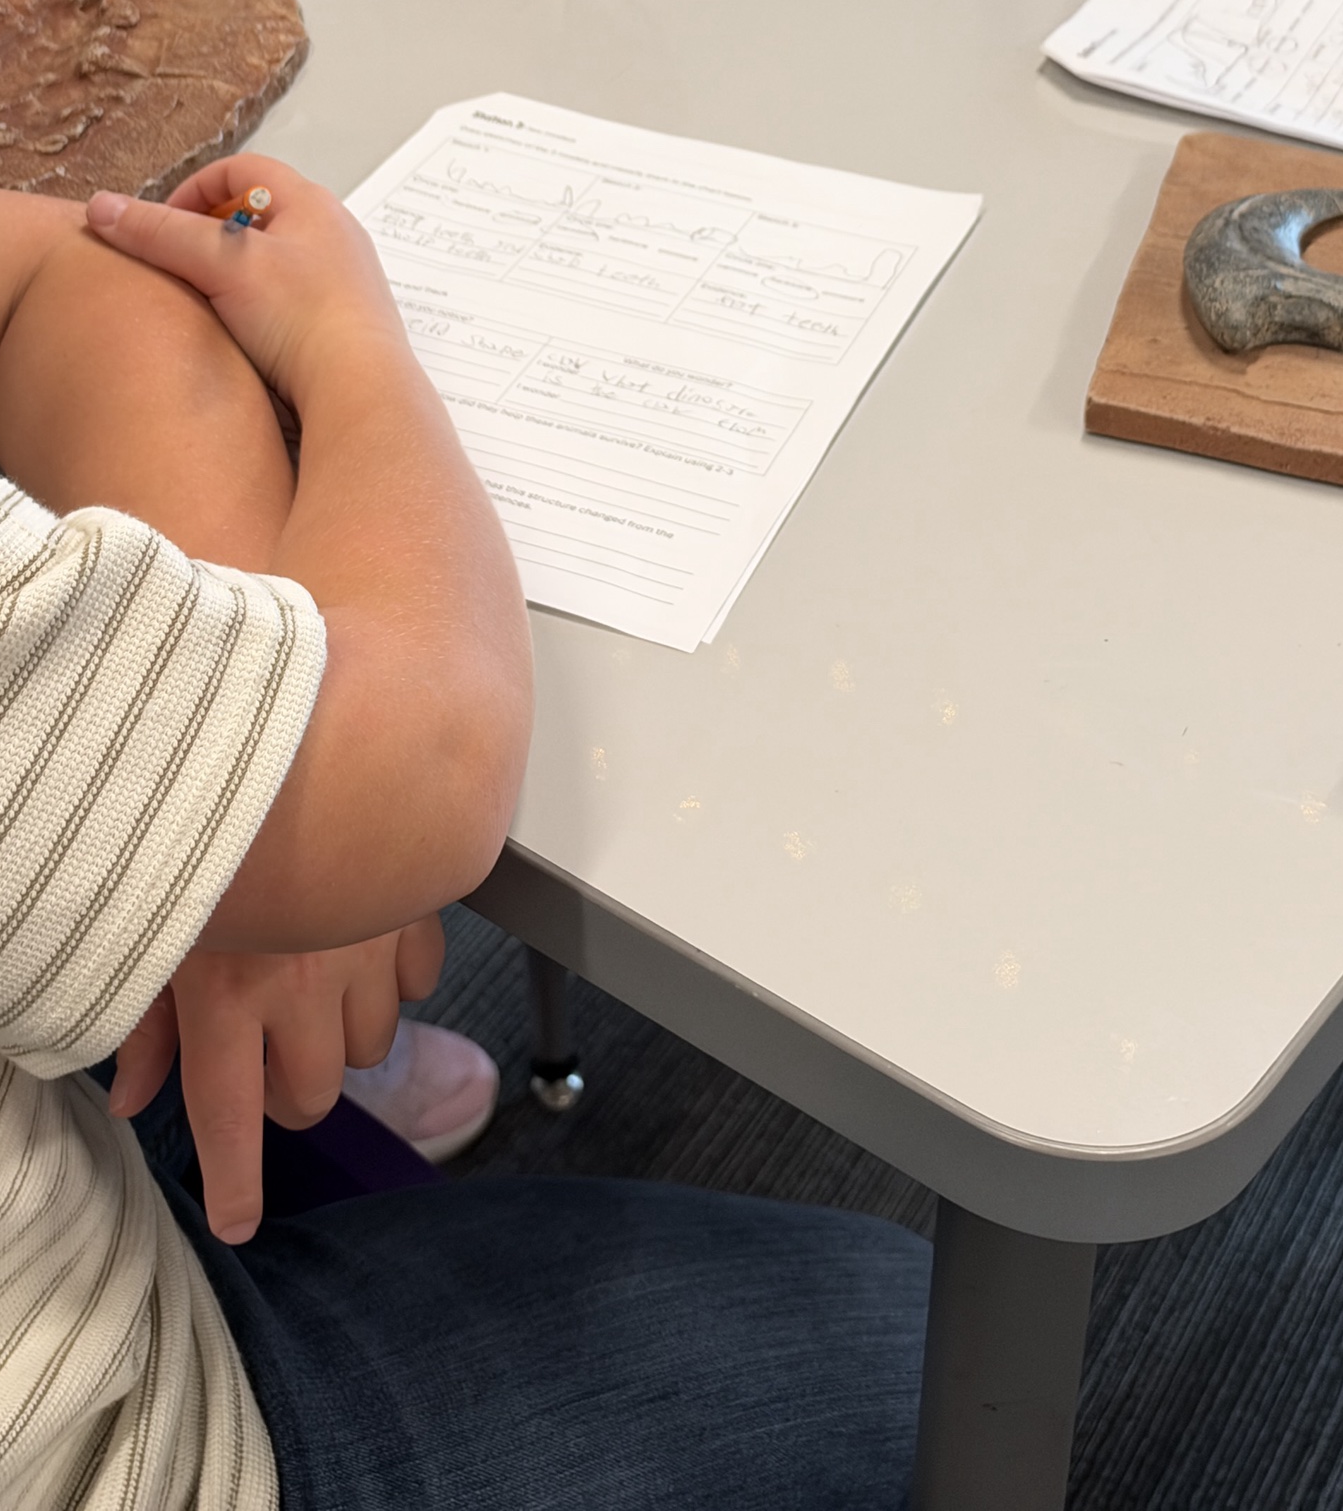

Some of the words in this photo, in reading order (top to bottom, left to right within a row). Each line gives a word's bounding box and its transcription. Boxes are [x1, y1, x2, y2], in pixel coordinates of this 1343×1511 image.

[556, 422, 598, 439] animals
[598, 432, 642, 451] survive?
[643, 444, 684, 462] Explain
[683, 455, 715, 471] using
[715, 464, 735, 476] 2-3
[504, 484, 526, 496] this
[527, 491, 577, 512] structure
[577, 505, 626, 526] changed
[627, 520, 654, 533] from
[654, 528, 674, 539] the
